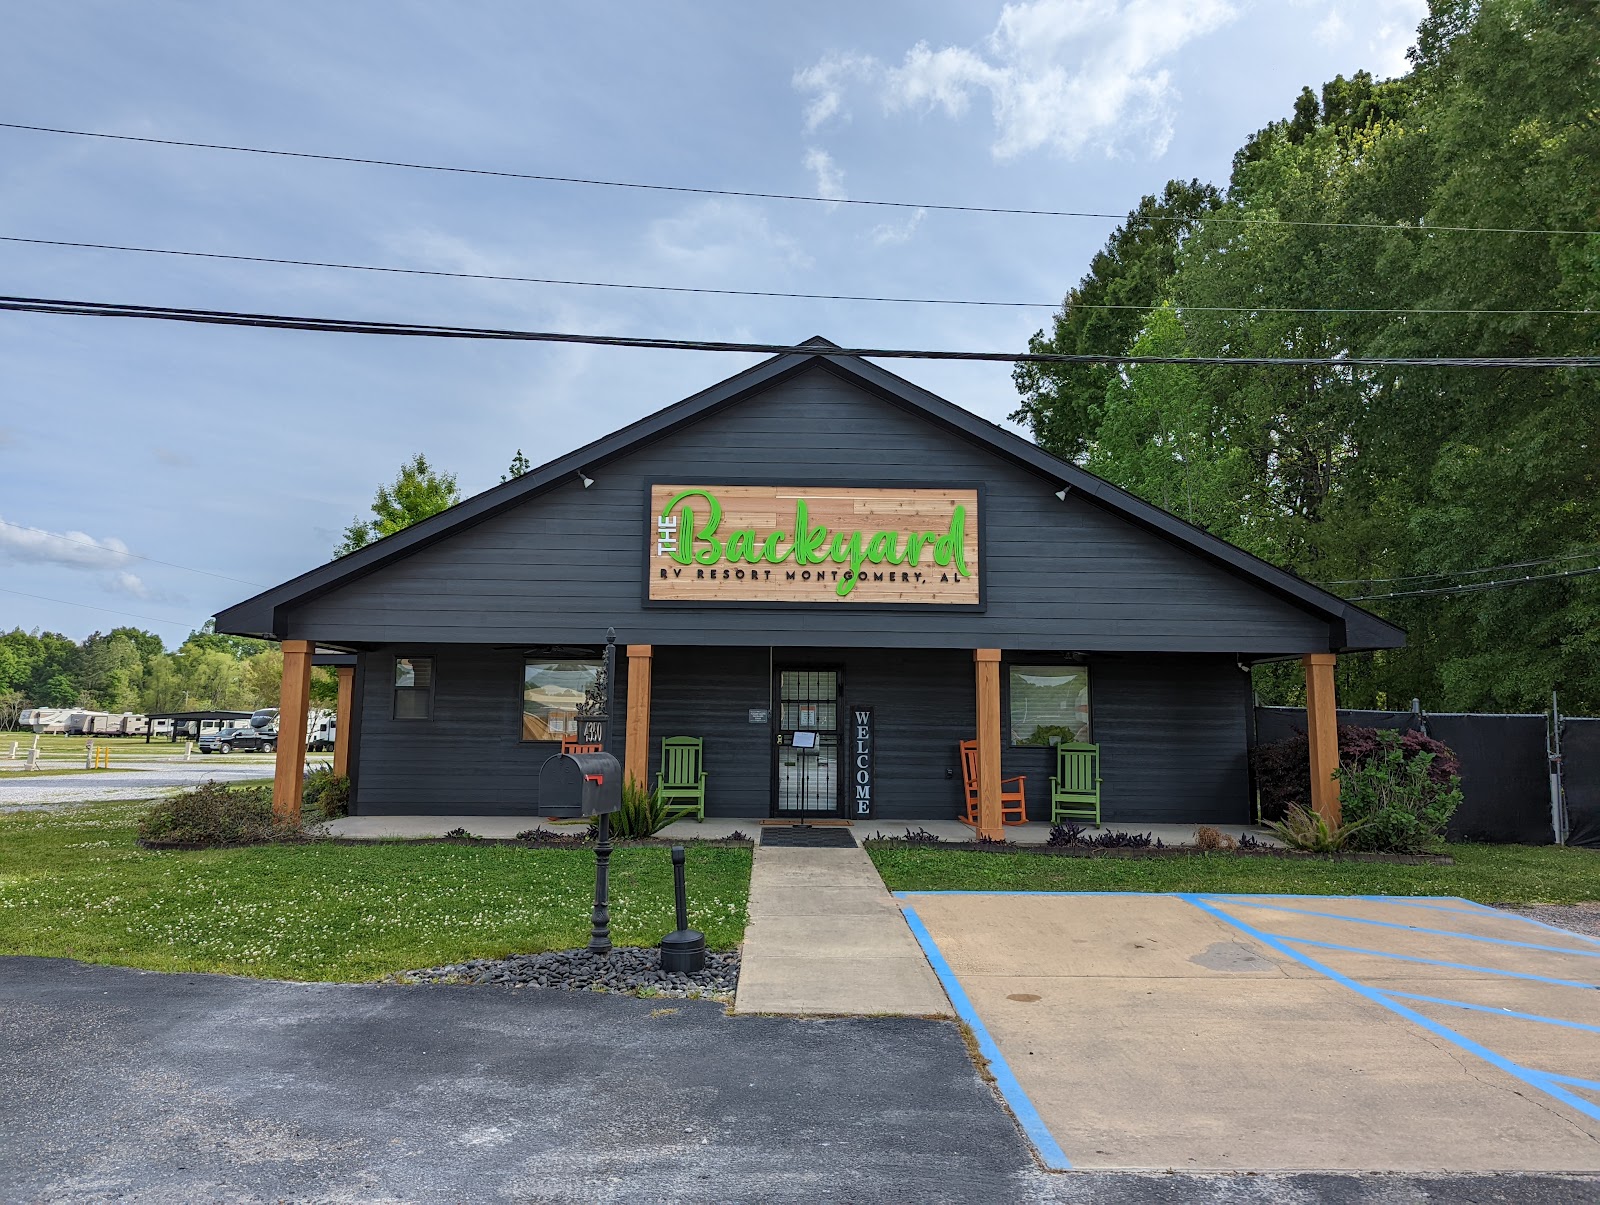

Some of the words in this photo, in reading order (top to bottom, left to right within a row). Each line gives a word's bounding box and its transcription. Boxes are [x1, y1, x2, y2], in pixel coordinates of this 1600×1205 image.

[658, 515, 677, 556] THE
[661, 489, 971, 596] Backyard
[660, 568, 682, 580] RV
[697, 568, 771, 581] RESORT
[785, 569, 926, 584] MONTGOMERY,
[940, 572, 961, 583] AL
[855, 711, 870, 814] WELCOME
